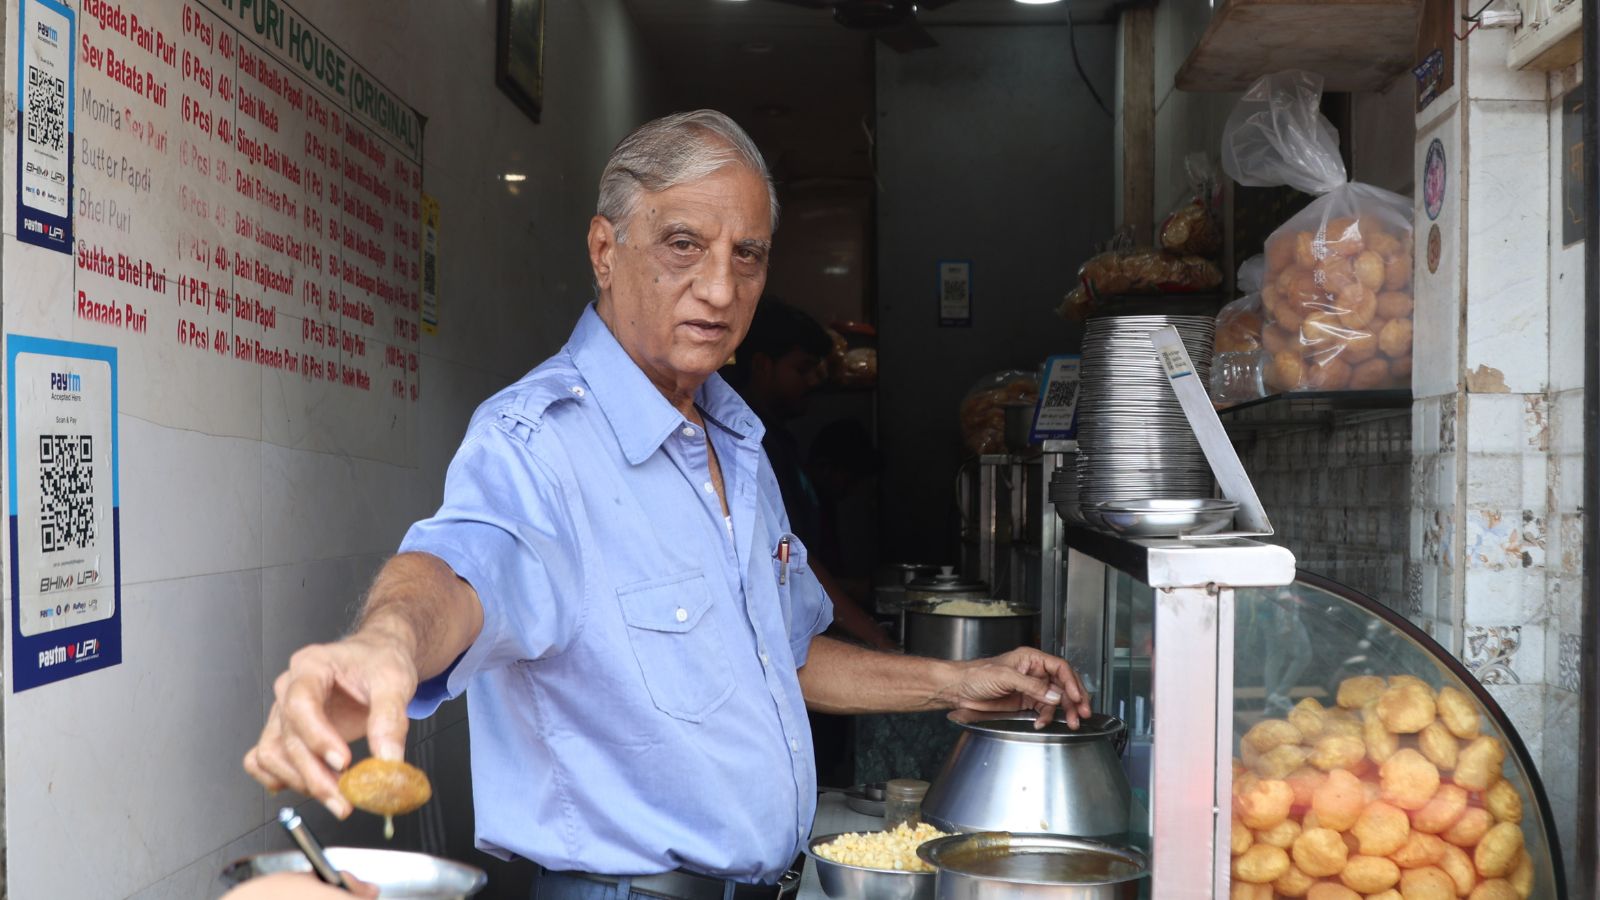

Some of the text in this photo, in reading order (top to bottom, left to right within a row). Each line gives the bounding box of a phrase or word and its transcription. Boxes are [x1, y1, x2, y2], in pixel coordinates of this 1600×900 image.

[130, 13, 153, 54] Pani
[157, 31, 176, 68] Puri
[182, 48, 191, 81] (6
[194, 56, 213, 98] Pcs)
[218, 73, 234, 103] 40/-
[182, 3, 234, 61] (6 Pcs) 40/-
[82, 33, 233, 145] Sev Batata Puri (6 Pcs) 40/-
[239, 44, 256, 79] Dahi
[259, 58, 281, 96] Bhalla
[284, 76, 302, 110] Papdi
[314, 99, 328, 133] Pcs)
[289, 16, 346, 96] HOUSE
[350, 67, 419, 160] (ORIGINAL)
[81, 87, 121, 130] Monita
[147, 121, 168, 155] Puri
[238, 86, 256, 120] Dahi
[258, 99, 278, 133] Wada
[313, 135, 327, 170] Pcs)
[81, 138, 118, 181] Butter
[121, 156, 151, 195] Papdi
[236, 168, 254, 199] Dahi
[282, 193, 297, 220] Puri
[237, 127, 261, 165] Single
[264, 142, 280, 174] Dahi
[282, 153, 301, 185] Wada
[312, 171, 323, 204] Pc)
[49, 225, 65, 240] UPI
[79, 187, 105, 224] Bhel
[109, 200, 131, 234] Puri
[215, 245, 231, 273] 40/-
[235, 211, 253, 240] Dahi
[255, 222, 284, 254] Samosa
[286, 234, 302, 262] Chat
[77, 240, 231, 315] Sukha Bhel Puri (1 PLT) 40/-
[235, 251, 253, 281] Dahi
[255, 260, 293, 297] Rajkachori
[311, 282, 322, 314] Pc)
[78, 290, 230, 355] Ragada Puri (6 Pcs) 40/-
[235, 293, 253, 322] Dahi
[255, 300, 276, 333] Papdi
[311, 319, 324, 349] Pcs)
[355, 334, 366, 357] Puri
[235, 335, 253, 363] Dahi
[255, 340, 282, 369] Ragada
[284, 348, 298, 374] Puri
[310, 355, 324, 379] Pcs)
[51, 393, 81, 402] Accepted Here
[55, 416, 65, 424] Scan
[69, 416, 77, 425] Pay
[40, 570, 98, 593] BHIM UPI
[76, 639, 99, 659] UPI
